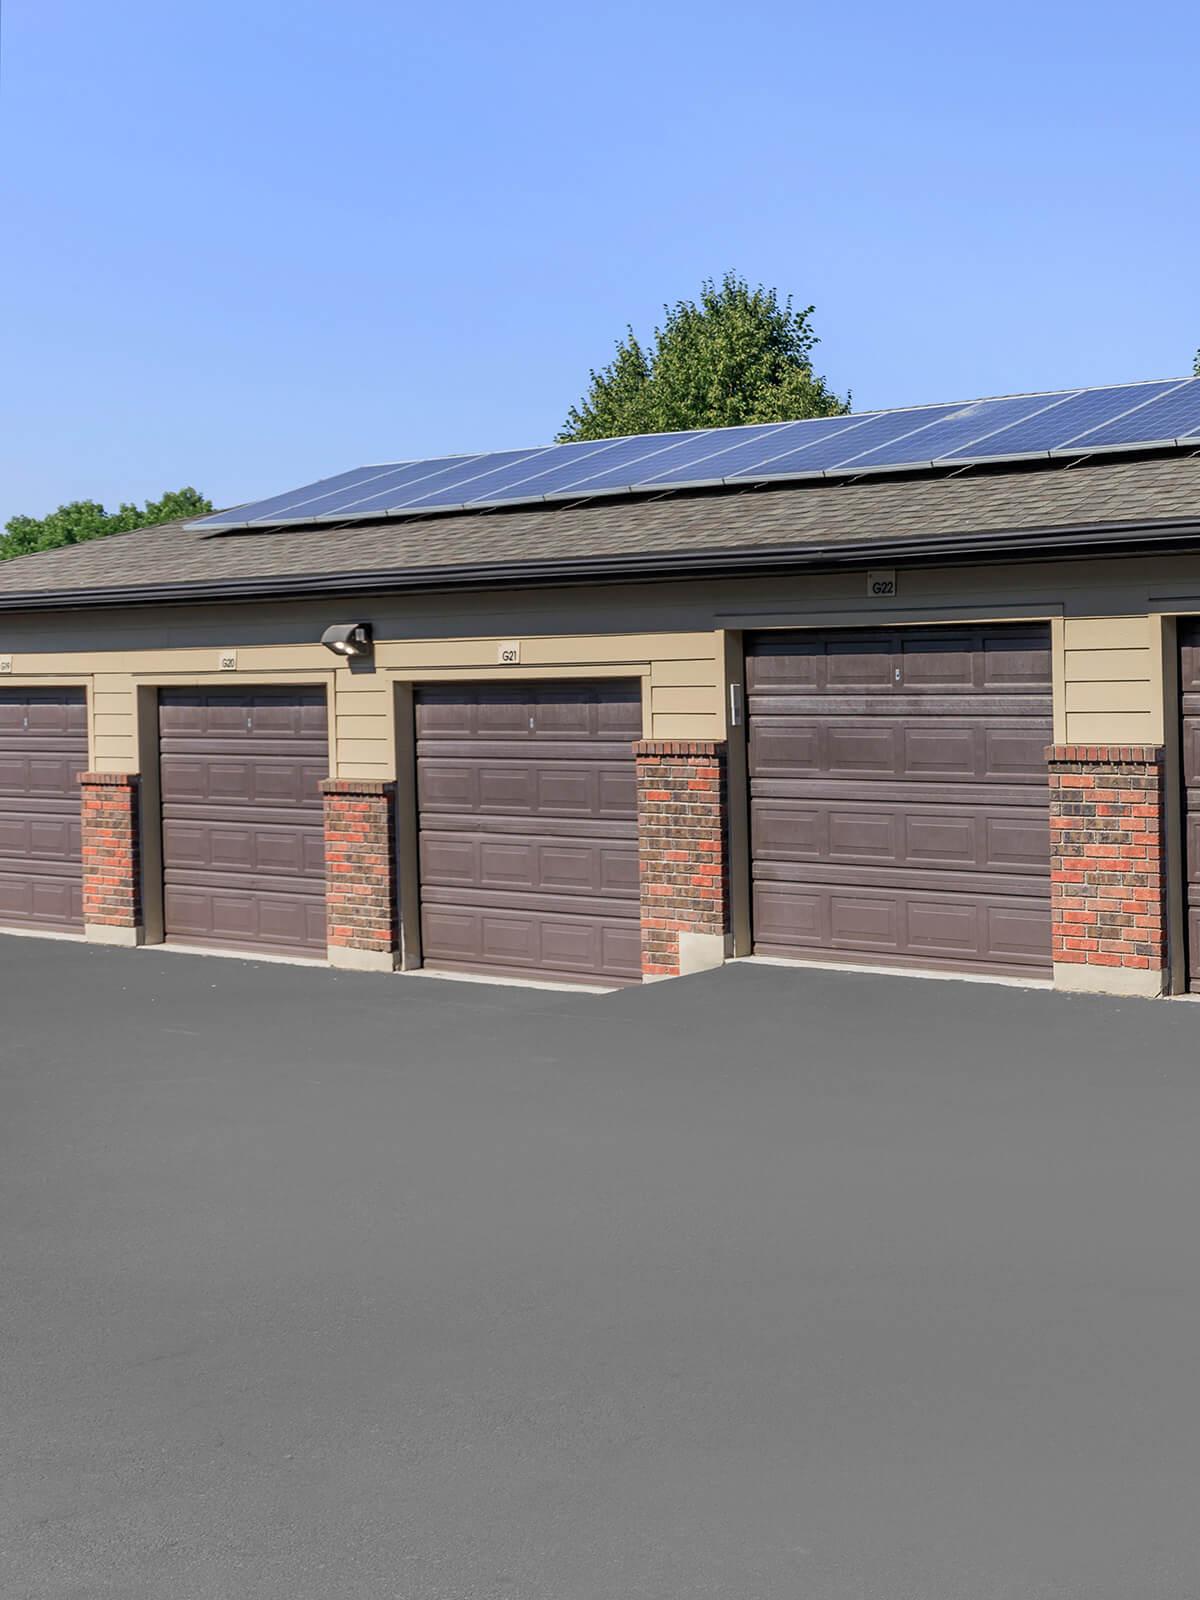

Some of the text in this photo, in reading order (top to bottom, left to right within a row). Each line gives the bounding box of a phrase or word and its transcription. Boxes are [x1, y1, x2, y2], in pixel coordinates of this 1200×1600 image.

[872, 582, 893, 594] G22
[503, 650, 516, 661] G21
[223, 658, 234, 668] G20
